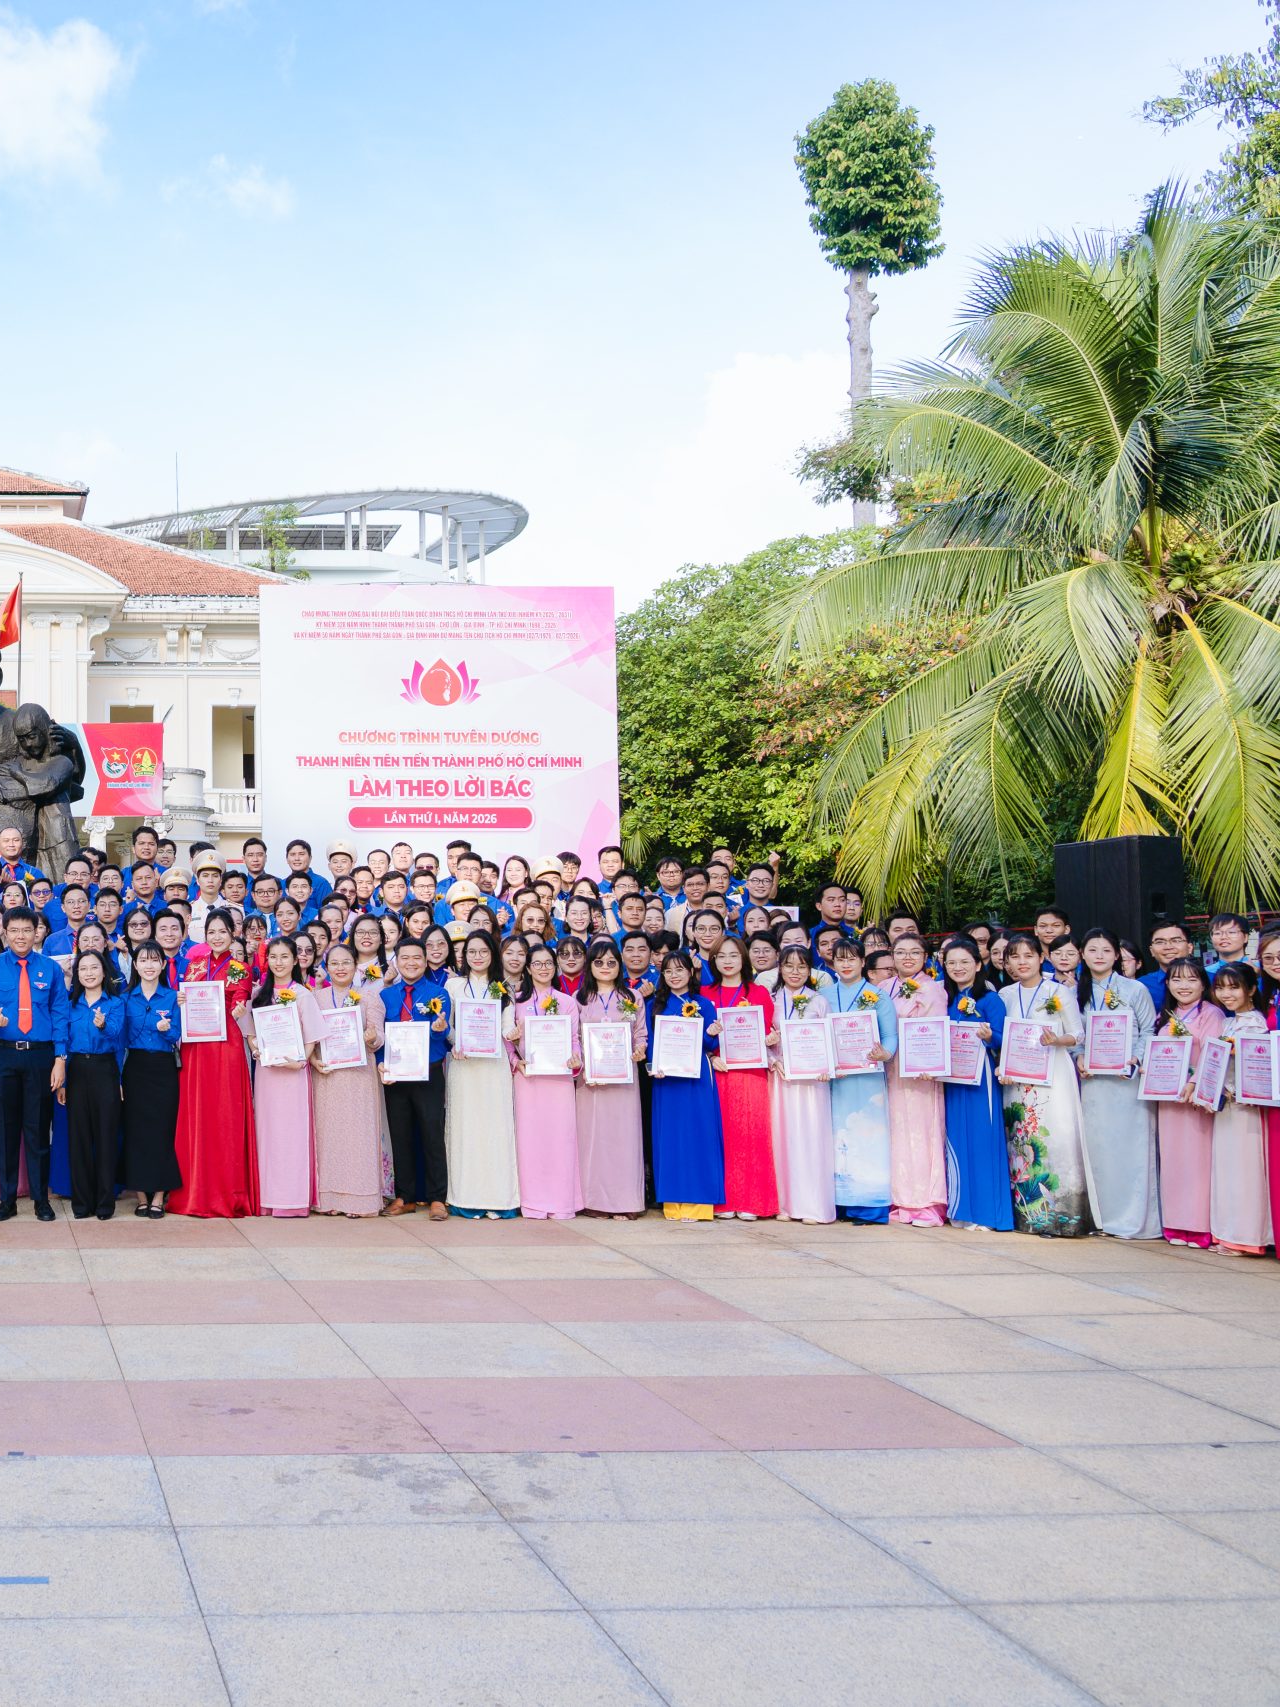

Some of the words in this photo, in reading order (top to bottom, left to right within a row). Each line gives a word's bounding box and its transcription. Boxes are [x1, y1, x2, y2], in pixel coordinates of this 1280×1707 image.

[338, 730, 396, 743] CHƯƠNG
[400, 730, 440, 743] TRÌNH
[444, 730, 486, 744] TUYÊN
[492, 730, 540, 744] DƯƠNG
[296, 756, 338, 767] THANH
[342, 753, 370, 767] NIÊN
[373, 754, 400, 768] TIÊN
[402, 752, 429, 768] TIẾN
[432, 754, 474, 768] THÀNH
[478, 752, 504, 768] PHỐ
[507, 752, 524, 768] HỒ
[528, 754, 548, 768] CHÍ
[551, 756, 582, 768] MINH
[350, 774, 391, 796] LÀM
[396, 780, 450, 797] THEO
[454, 774, 486, 797] LỜI
[490, 774, 532, 797] BÁC
[384, 811, 406, 824] LẦN
[410, 812, 433, 824] THỨ
[435, 814, 441, 826] I,
[444, 812, 468, 824] NĂM
[472, 814, 497, 824] 2026
